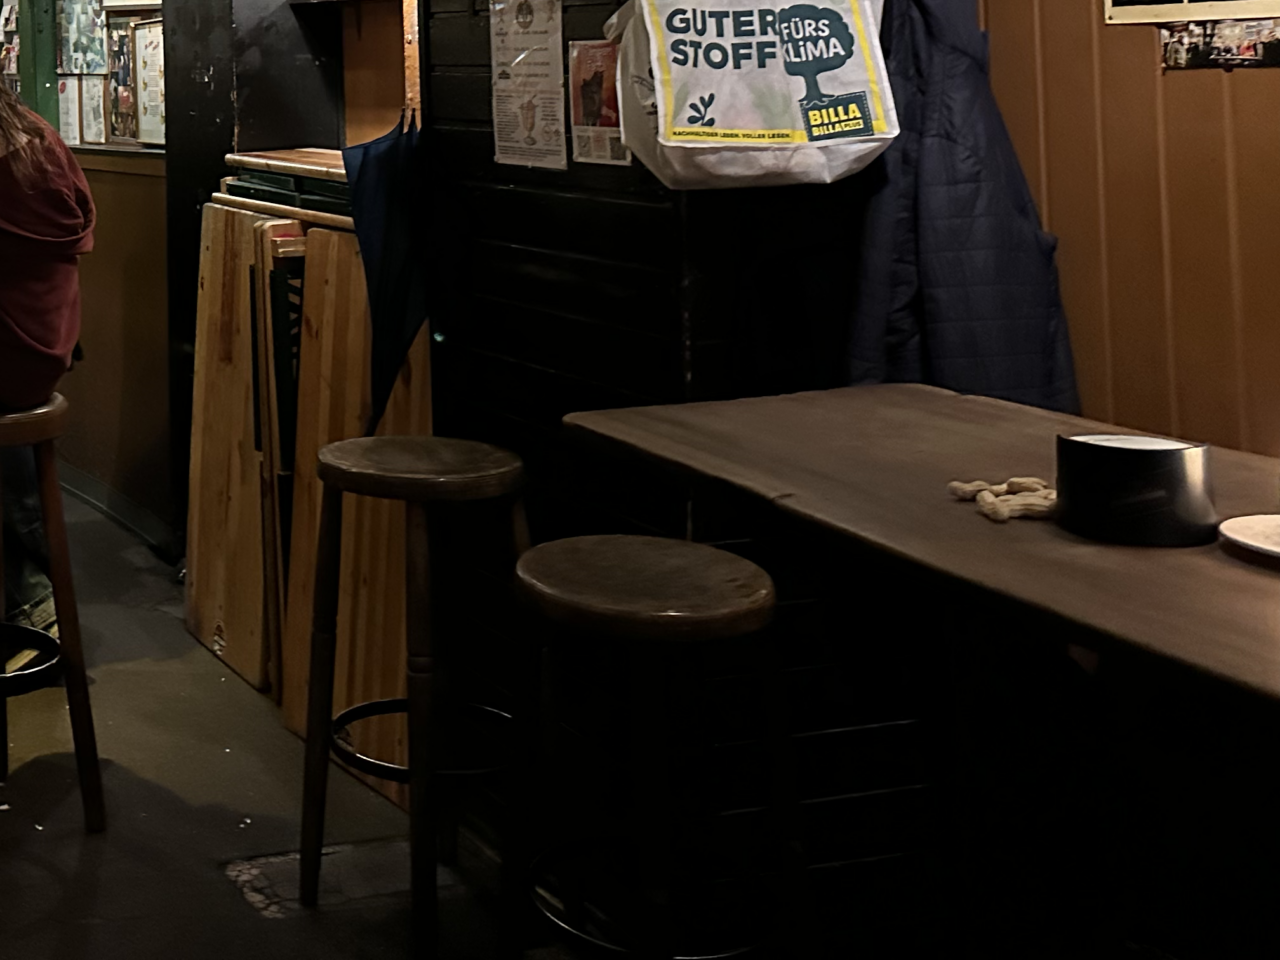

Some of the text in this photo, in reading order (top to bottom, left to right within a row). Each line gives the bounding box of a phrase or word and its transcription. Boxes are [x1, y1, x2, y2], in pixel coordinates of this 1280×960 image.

[666, 7, 779, 38] GUTER
[780, 17, 830, 41] FÜRS
[670, 37, 777, 69] STOFF
[808, 102, 863, 126] BILLA
[812, 120, 863, 137] BILLA PLUS
